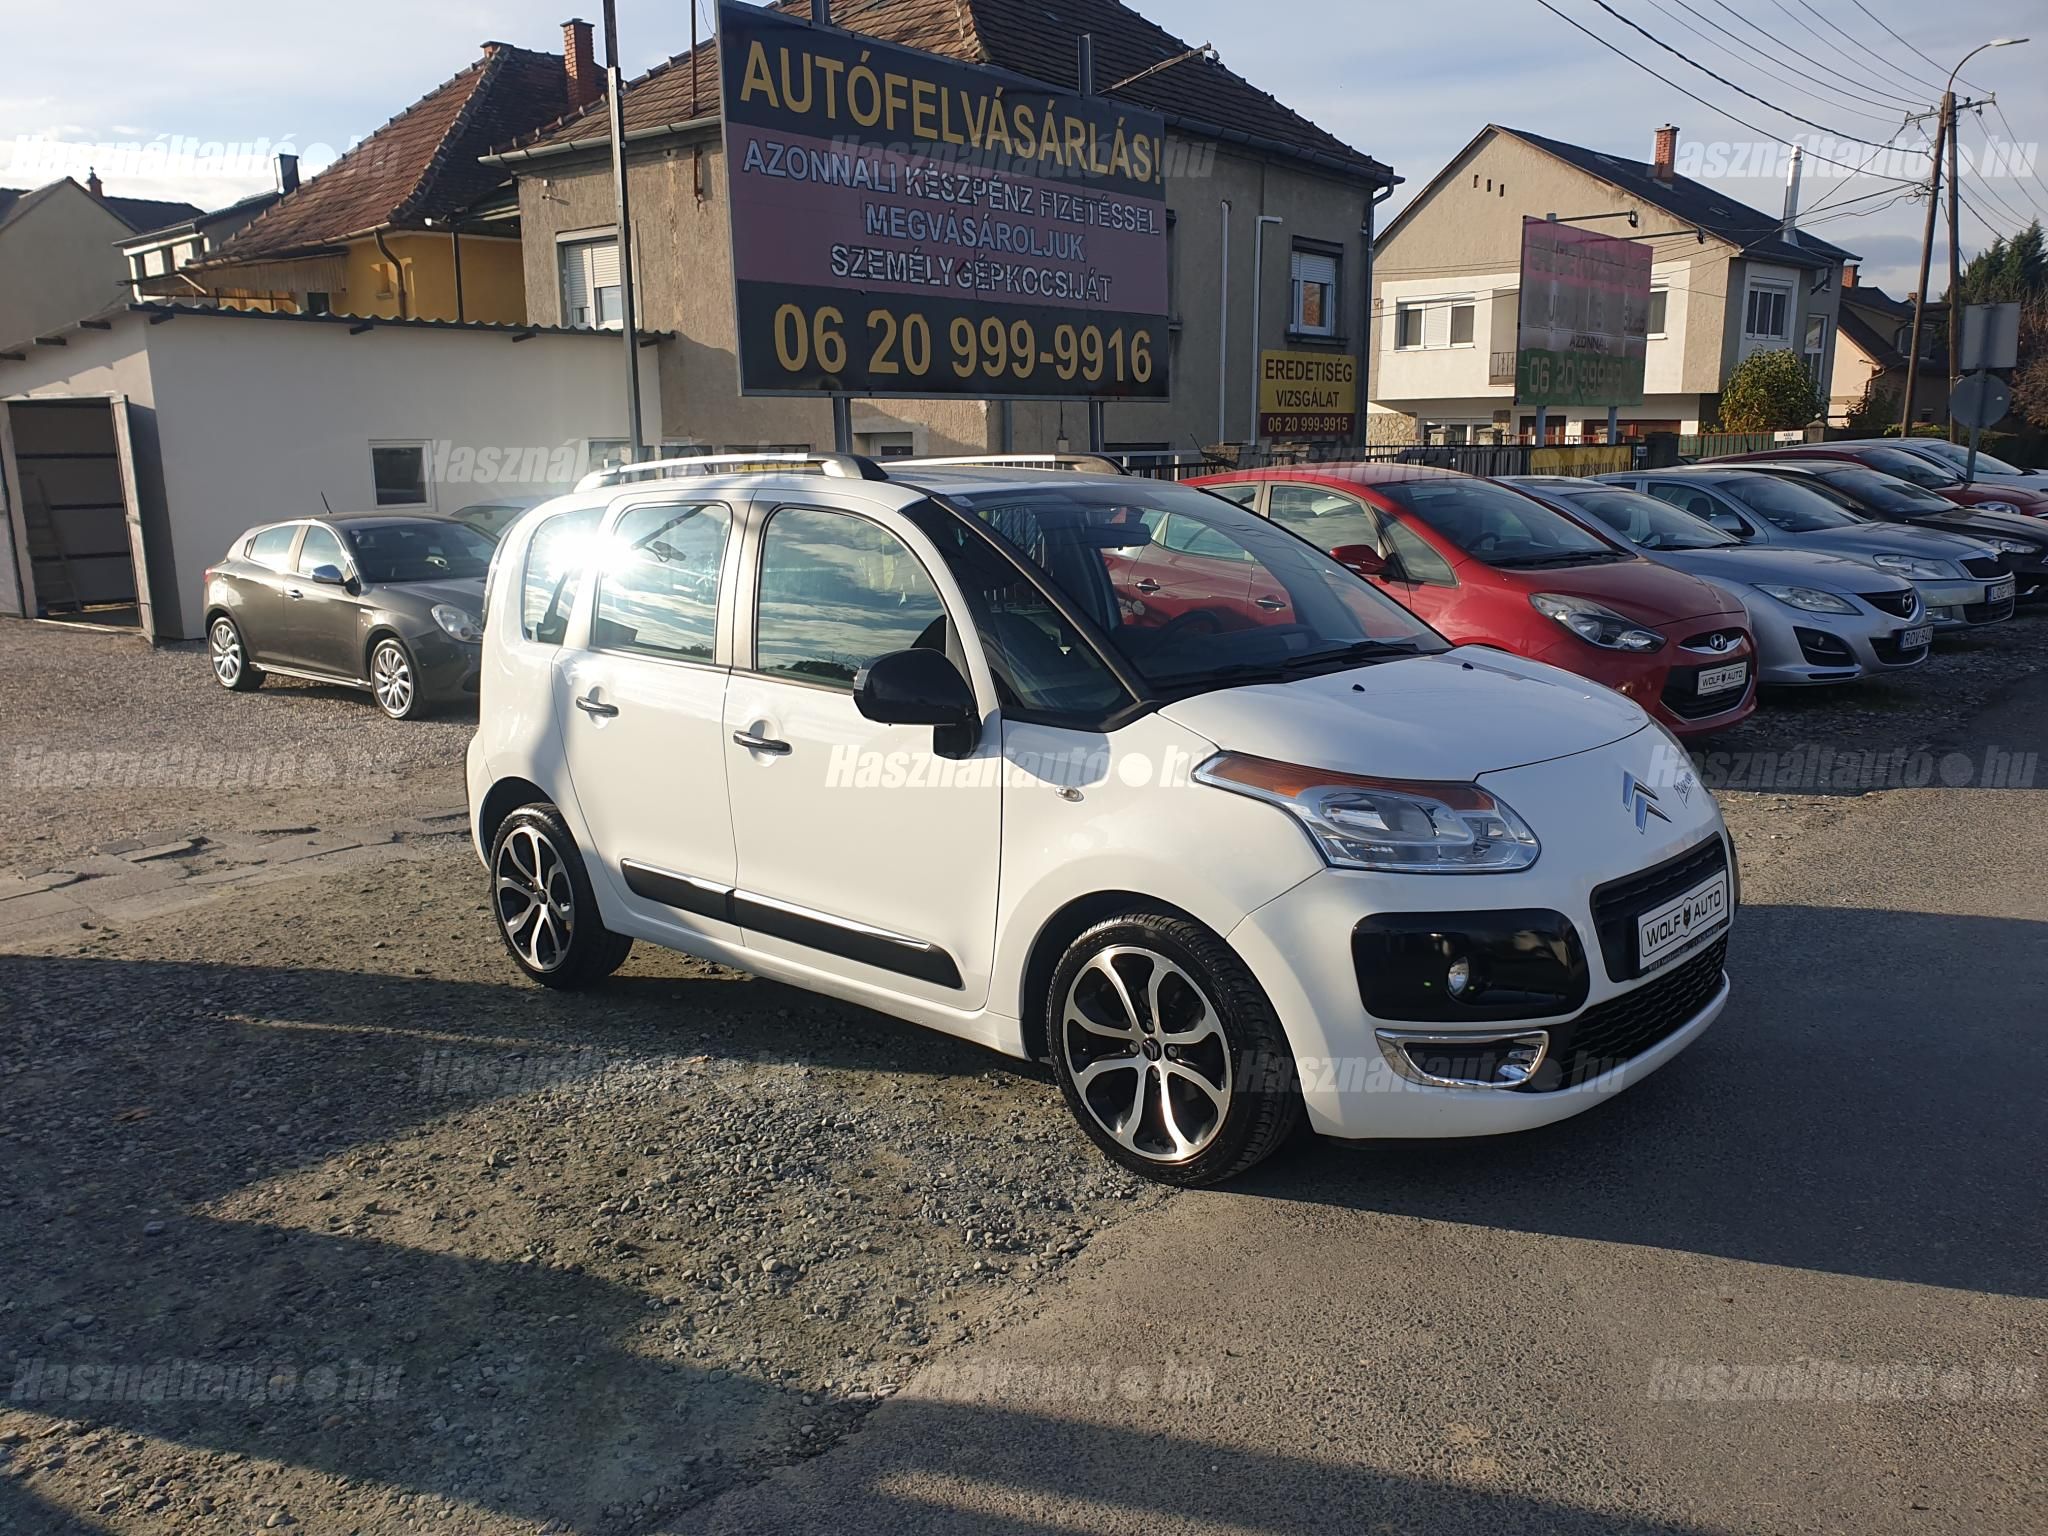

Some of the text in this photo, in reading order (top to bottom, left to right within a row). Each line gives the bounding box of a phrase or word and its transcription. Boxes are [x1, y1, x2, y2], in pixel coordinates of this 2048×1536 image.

[740, 40, 1161, 184] AUTÓFELVÁSÁRLÁS!
[743, 139, 1160, 236] AZONNALI KÉSZPÉNZ FIZETÉSSEL
[866, 204, 1086, 262] MEGVÁSÁROLJUK
[773, 304, 1153, 384] 06 20 999-9916
[1265, 357, 1353, 383] EREDETISÉG
[1268, 416, 1348, 432] 06 20 999-9915
[1276, 387, 1340, 408] VIZSGÁLAT
[1702, 670, 1742, 687] WOLF AUTO
[1646, 890, 1720, 947] WOLF AUTO
